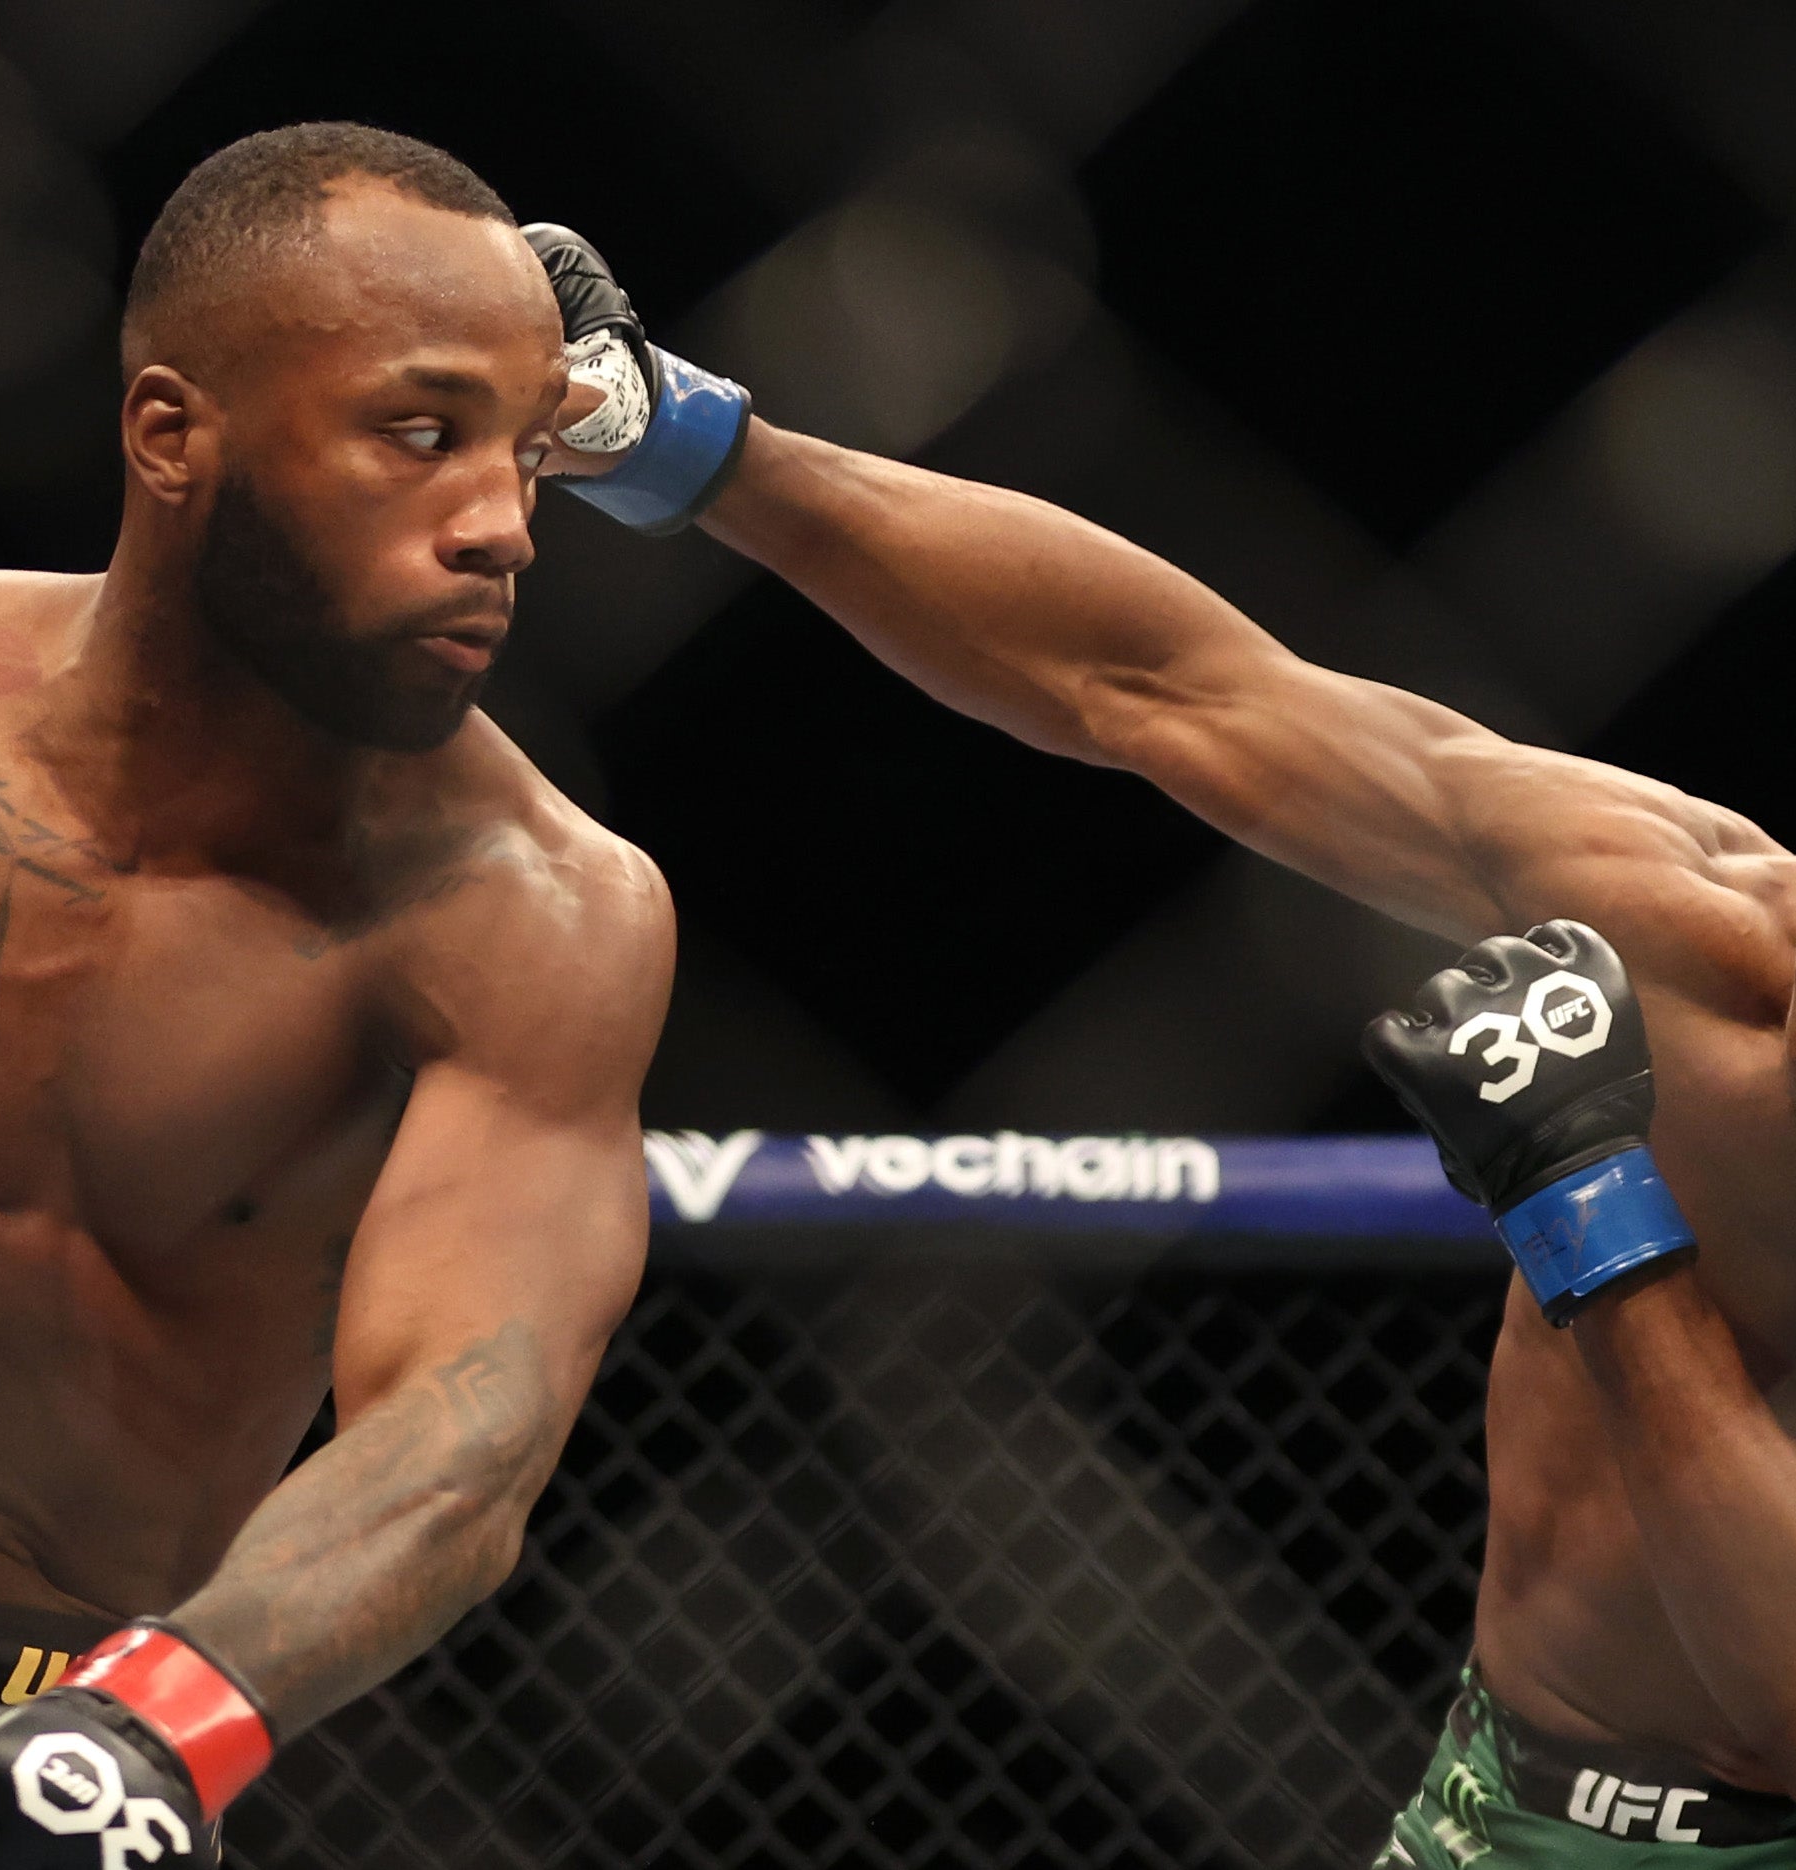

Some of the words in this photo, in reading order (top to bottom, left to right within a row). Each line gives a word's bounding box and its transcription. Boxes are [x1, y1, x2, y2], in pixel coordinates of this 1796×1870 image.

[1448, 969, 1613, 1105] 30
[1547, 995, 1592, 1031] UFC
[1567, 1767, 1710, 1844] UFC
